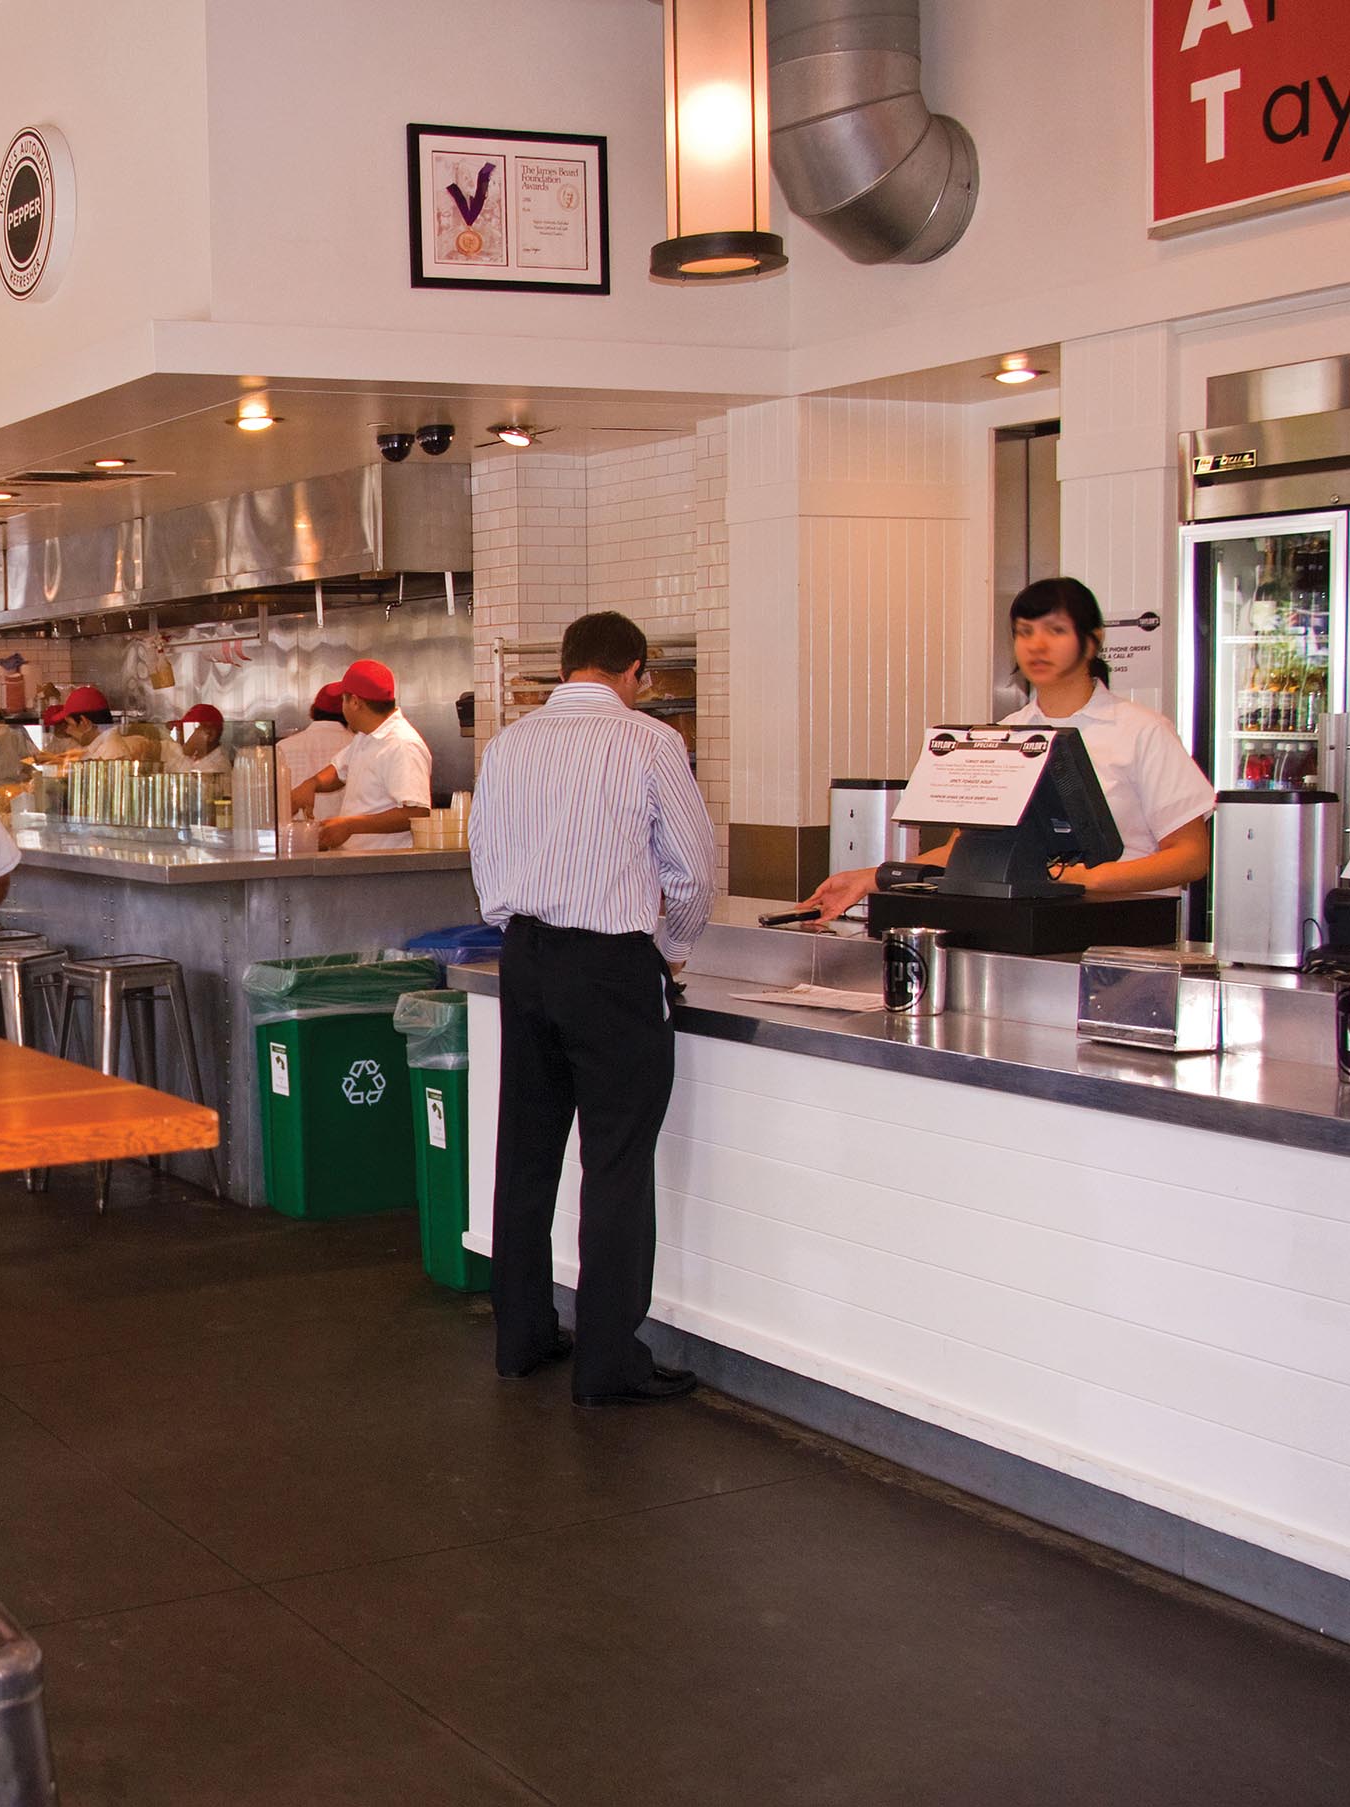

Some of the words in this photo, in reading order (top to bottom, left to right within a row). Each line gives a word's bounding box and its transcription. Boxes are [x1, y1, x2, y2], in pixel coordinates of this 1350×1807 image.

[20, 140, 50, 189] AUTOMATIC
[521, 165, 536, 175] The
[536, 166, 558, 176] James
[558, 167, 579, 177] Beard
[521, 174, 562, 184] Foundation
[521, 182, 550, 191] Awards
[8, 196, 41, 231] PEPPER
[9, 257, 41, 288] REFRESHER
